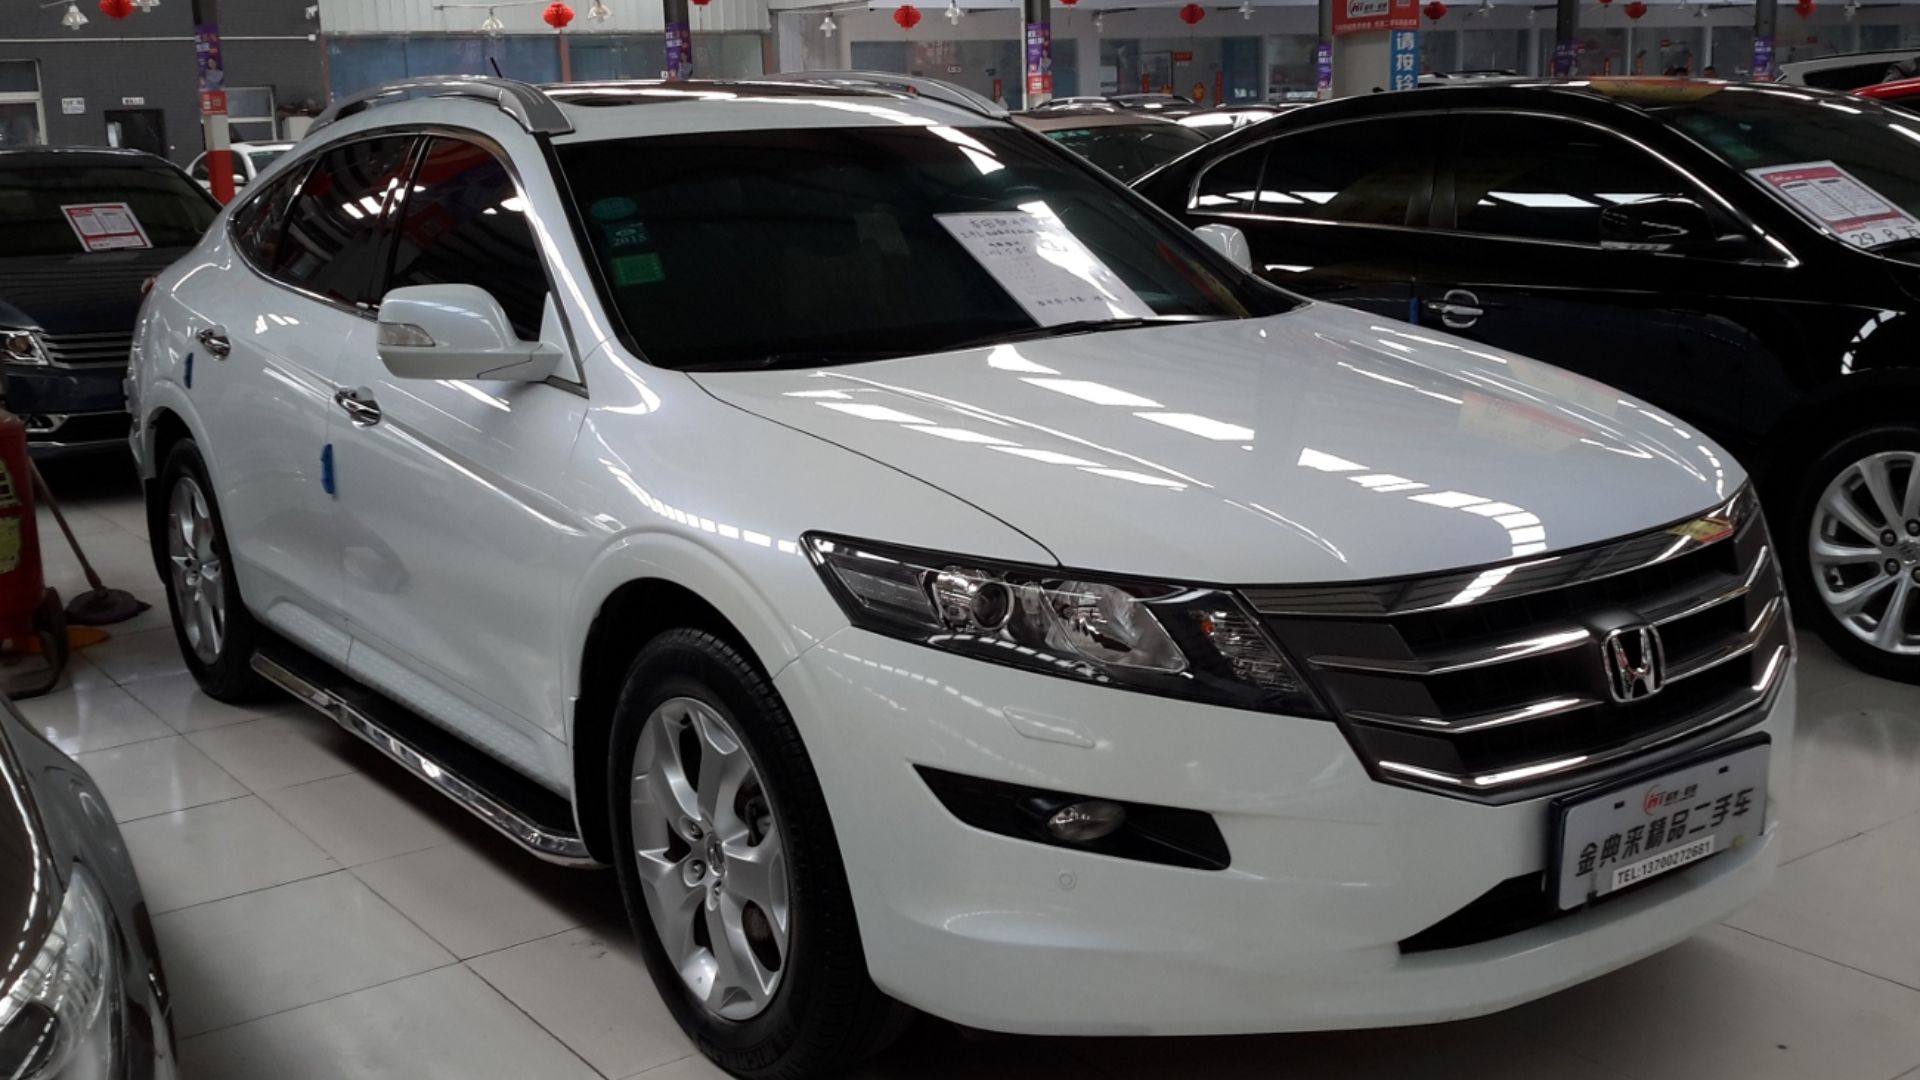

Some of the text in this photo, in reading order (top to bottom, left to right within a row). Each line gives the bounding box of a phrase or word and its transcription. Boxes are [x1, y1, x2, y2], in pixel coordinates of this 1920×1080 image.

[1576, 787, 1755, 876] 金典来精品二手车
